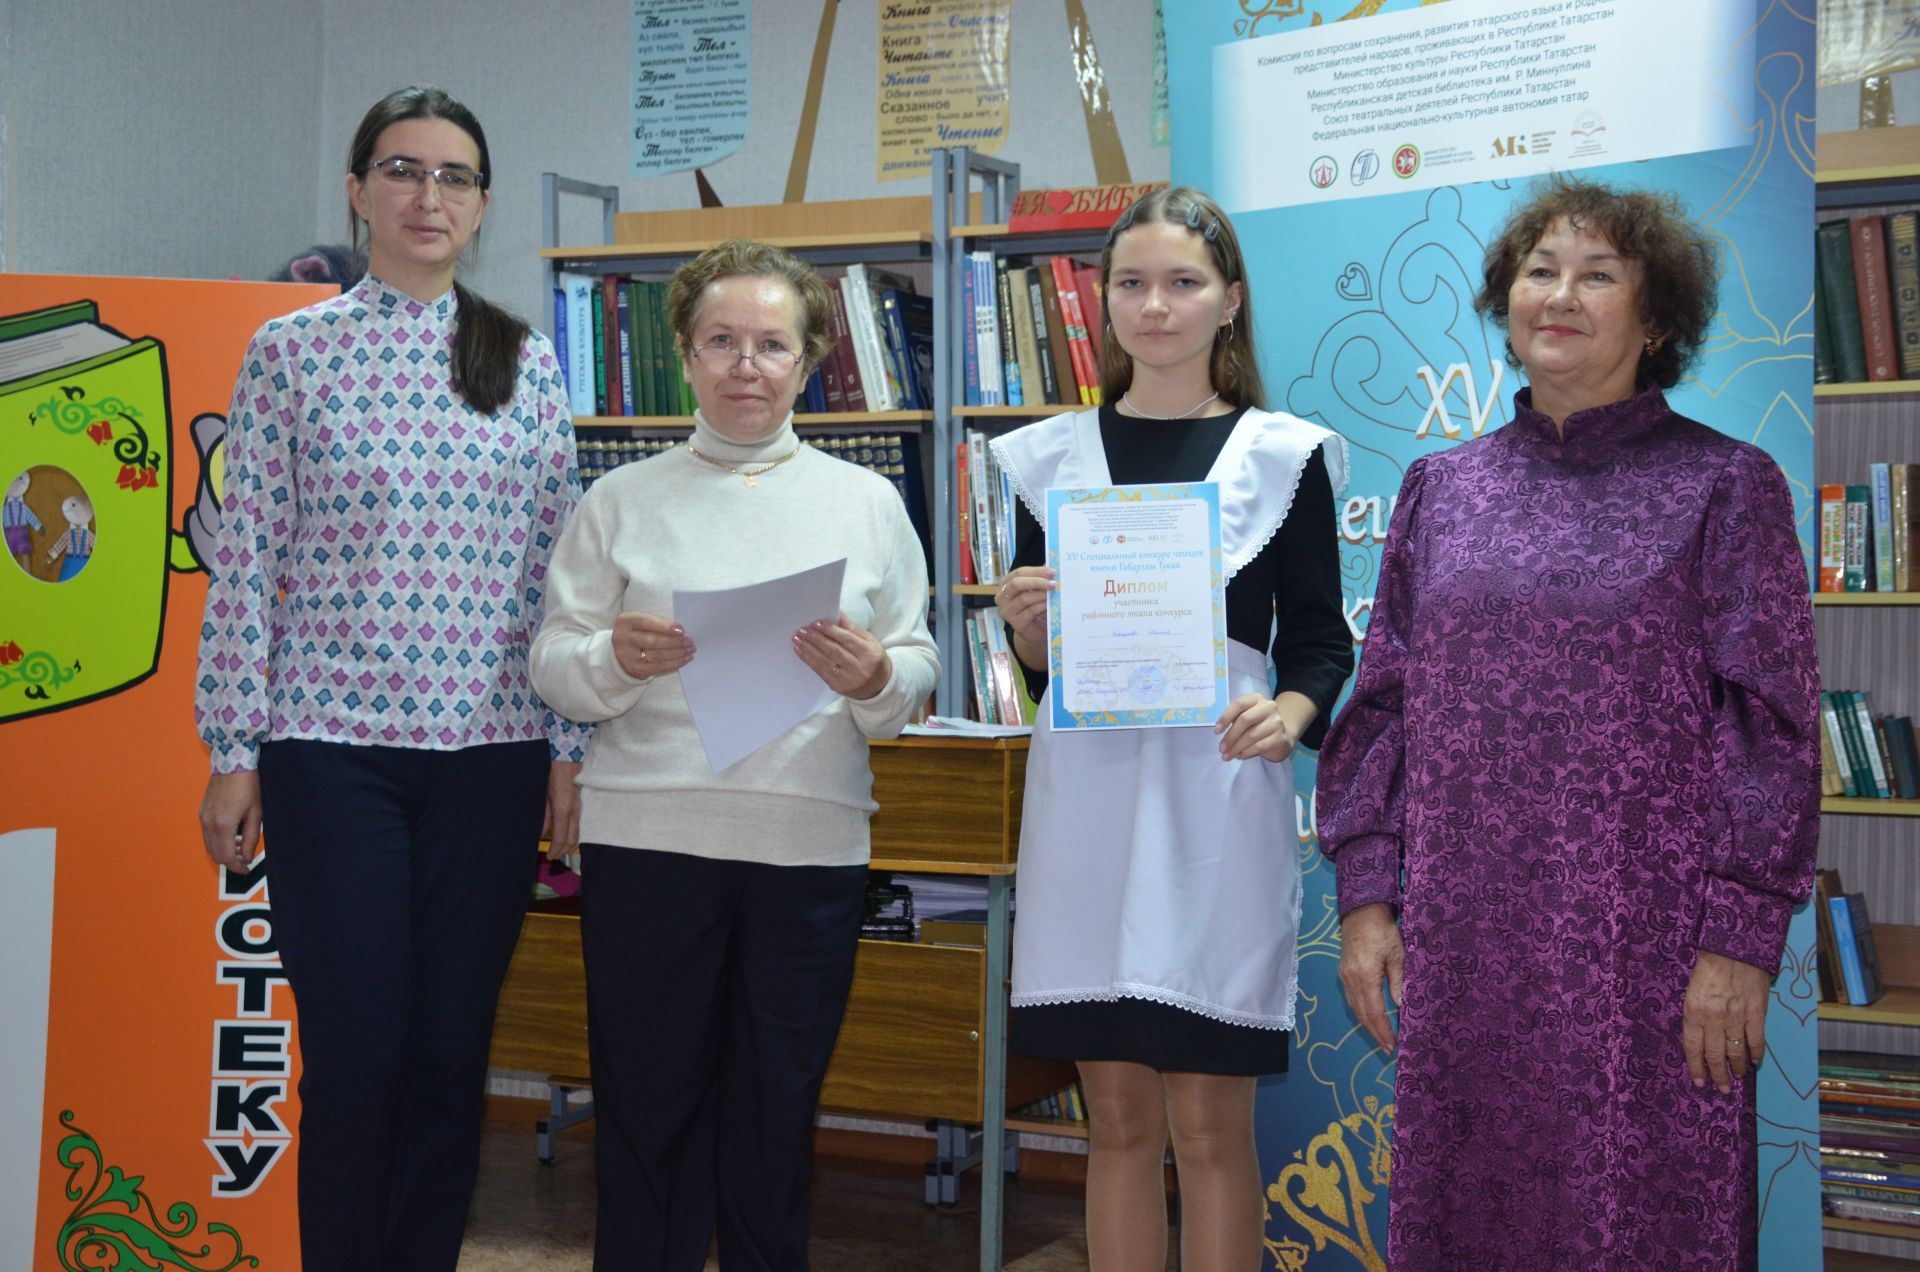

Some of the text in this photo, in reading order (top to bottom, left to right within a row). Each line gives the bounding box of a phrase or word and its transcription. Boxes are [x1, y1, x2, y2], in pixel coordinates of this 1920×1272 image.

[882, 4, 931, 20] Книга
[882, 36, 922, 47] Книга
[1257, 51, 1301, 67] Комиссия
[1303, 49, 1315, 59] по
[1316, 41, 1362, 57] вопросам
[1364, 29, 1423, 48] сохранения,
[1424, 21, 1470, 39] развития
[1472, 9, 1529, 29] татарского
[1531, 3, 1563, 16] языка
[1293, 9, 1615, 74] представителей народов, проживающих в Республике Татарстан
[693, 37, 726, 52] Тел
[882, 49, 953, 64] Читайте
[1333, 33, 1566, 81] Министерство культуры Республики Татарстан
[1307, 42, 1597, 99] Министерство образования и науки Республики Татарстан
[881, 72, 930, 88] Книга
[1311, 92, 1394, 113] Республиканская
[1395, 85, 1433, 101] детская
[1435, 77, 1493, 94] библиотека
[1495, 75, 1511, 84] им.
[1526, 59, 1591, 79] Миннуллина
[635, 95, 665, 109] Тел
[880, 100, 951, 114] Сказанное
[1323, 77, 1576, 125] Союз театральных деятелей Республики Татарстан
[895, 115, 928, 124] слово
[1311, 90, 1590, 141] Федеральная национально-культурная автономия татар
[936, 124, 1003, 141] Чтение
[578, 307, 587, 393] РУССКАЯ КУЛЬТУРА
[620, 329, 633, 406] ДРЕВНИЙ МИР
[827, 375, 833, 385] 7
[848, 374, 854, 385] 6
[1415, 359, 1503, 440] XV
[980, 517, 992, 581] РОССИЙСКАЯ
[1080, 551, 1137, 563] Специальный
[1138, 551, 1171, 561] конкурс
[1090, 562, 1180, 574] имени Габдуллы Тукая
[1104, 579, 1169, 597] Диплом
[1113, 598, 1159, 609] участника
[1081, 608, 1193, 622] районного этапа конкурса
